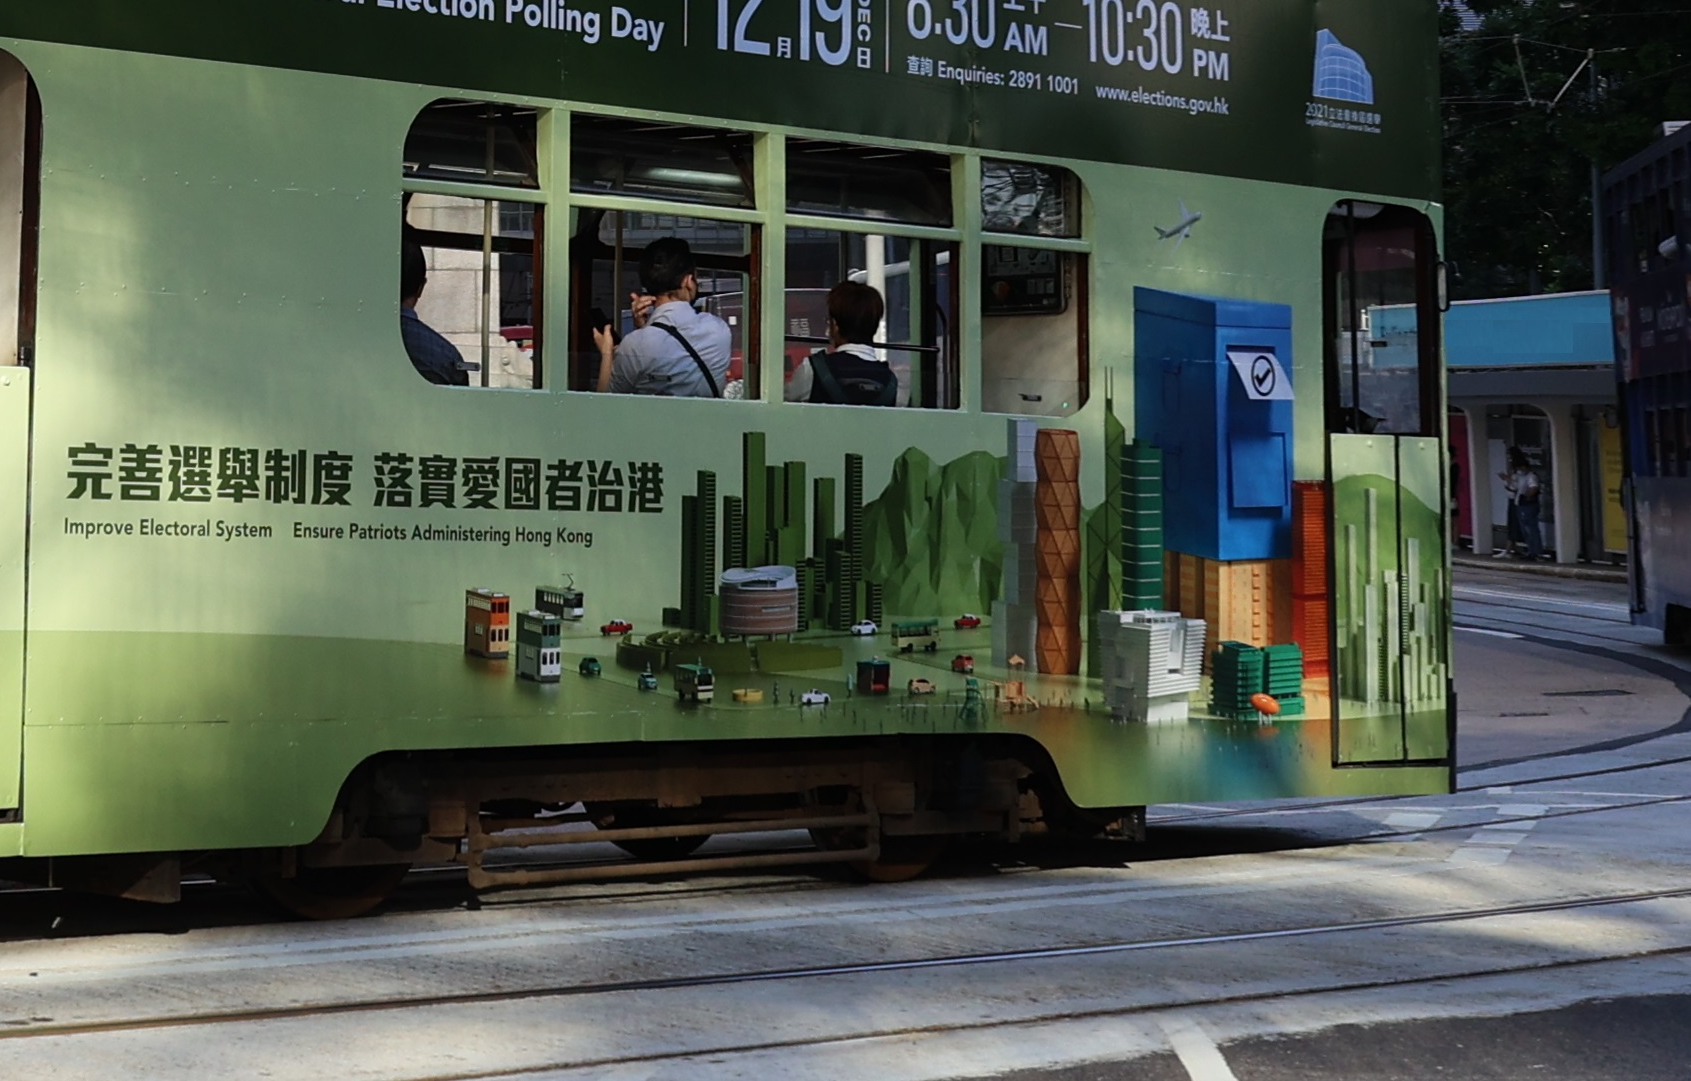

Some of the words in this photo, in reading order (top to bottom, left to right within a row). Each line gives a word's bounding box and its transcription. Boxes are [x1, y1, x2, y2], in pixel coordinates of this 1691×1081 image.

[611, 6, 665, 52] Day
[1189, 6, 1231, 42] 晚上
[1003, 21, 1048, 56] AM
[1192, 47, 1230, 81] PM
[937, 60, 1005, 86] Enquiries:
[1008, 69, 1042, 90] 2891
[1047, 75, 1079, 95] 1001
[1095, 84, 1230, 116] www.elections.gov.hk
[66, 442, 354, 506] 完善選舉制度
[373, 452, 664, 514] 落實愛國者治港
[64, 517, 134, 539] Improve
[139, 518, 210, 537] Electoral
[216, 520, 273, 542] System
[293, 522, 344, 539] Ensure
[349, 522, 407, 540] Patriots
[411, 524, 510, 546] Administering
[515, 526, 552, 547] Hong
[556, 527, 593, 548] Kong
